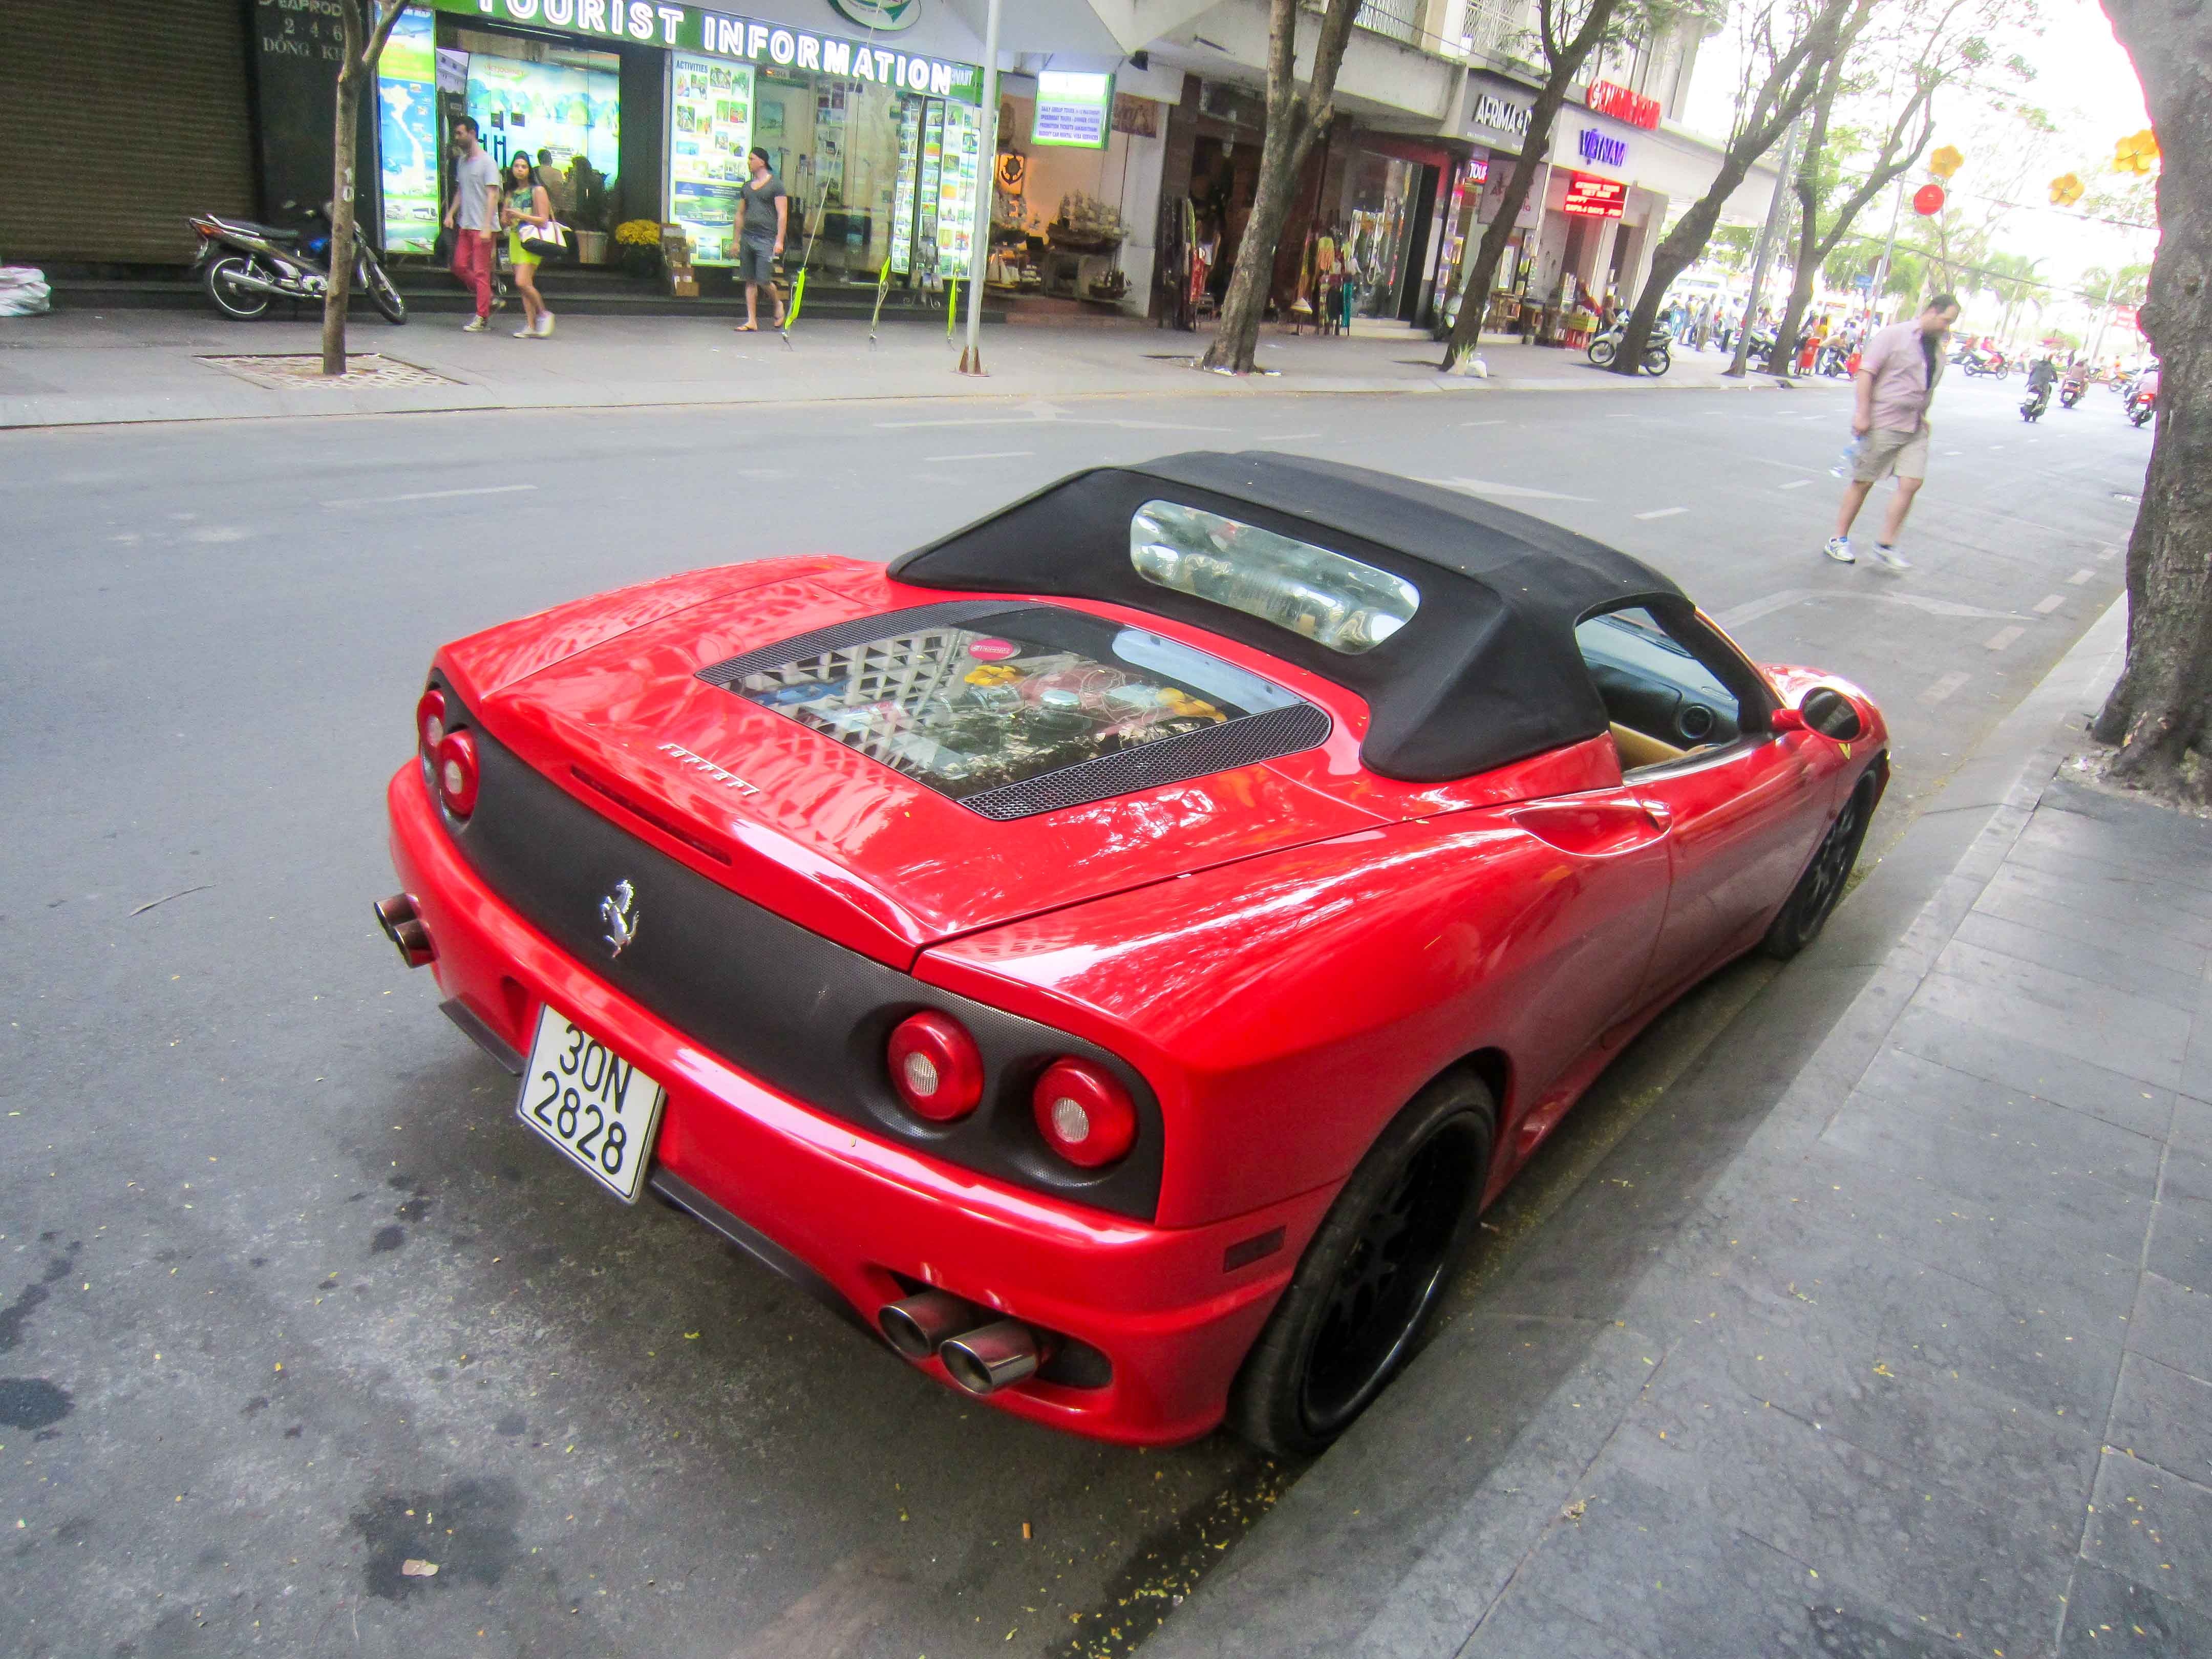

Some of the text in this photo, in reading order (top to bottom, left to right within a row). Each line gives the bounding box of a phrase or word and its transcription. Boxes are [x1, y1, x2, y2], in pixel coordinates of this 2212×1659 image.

[675, 59, 708, 73] ACTIVITIES
[704, 16, 952, 96] INFORMATION
[656, 743, 760, 796] Ferrari
[560, 1023, 633, 1114] 30N
[534, 1070, 627, 1175] 2828
